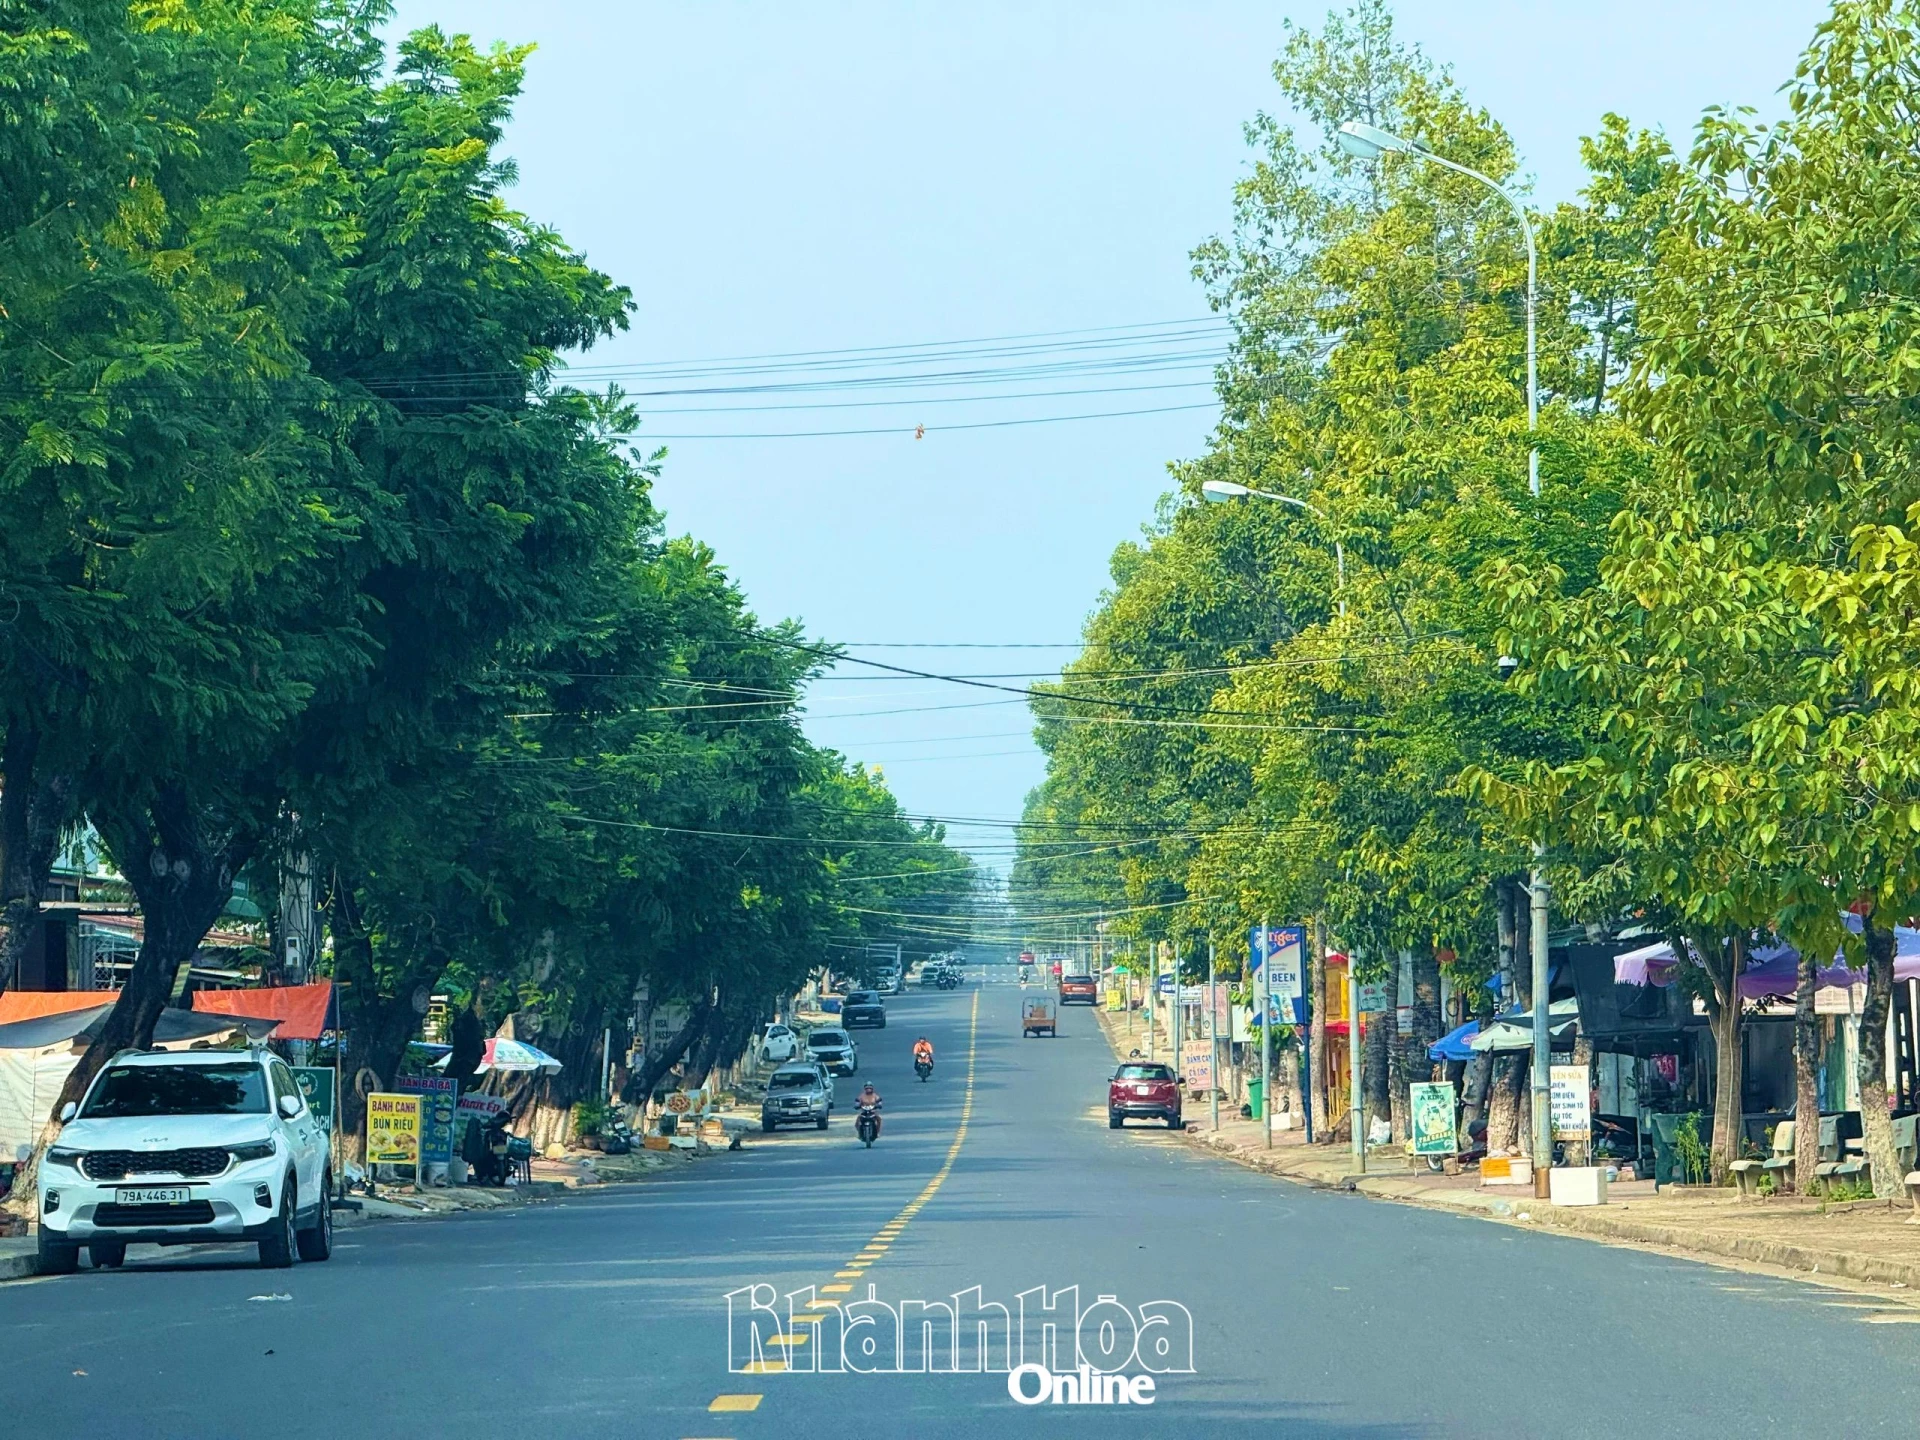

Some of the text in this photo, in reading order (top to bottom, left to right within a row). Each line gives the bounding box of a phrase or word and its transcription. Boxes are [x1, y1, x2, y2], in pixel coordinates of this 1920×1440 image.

[1268, 930, 1298, 947] Tiger
[1272, 972, 1296, 982] BEEN
[372, 1098, 393, 1112] BÁNH
[395, 1101, 416, 1113] CANH
[373, 1115, 413, 1131] BÚN RIÊU
[1572, 1122, 1588, 1130] KHON
[122, 1190, 183, 1202] 79A-446.31
